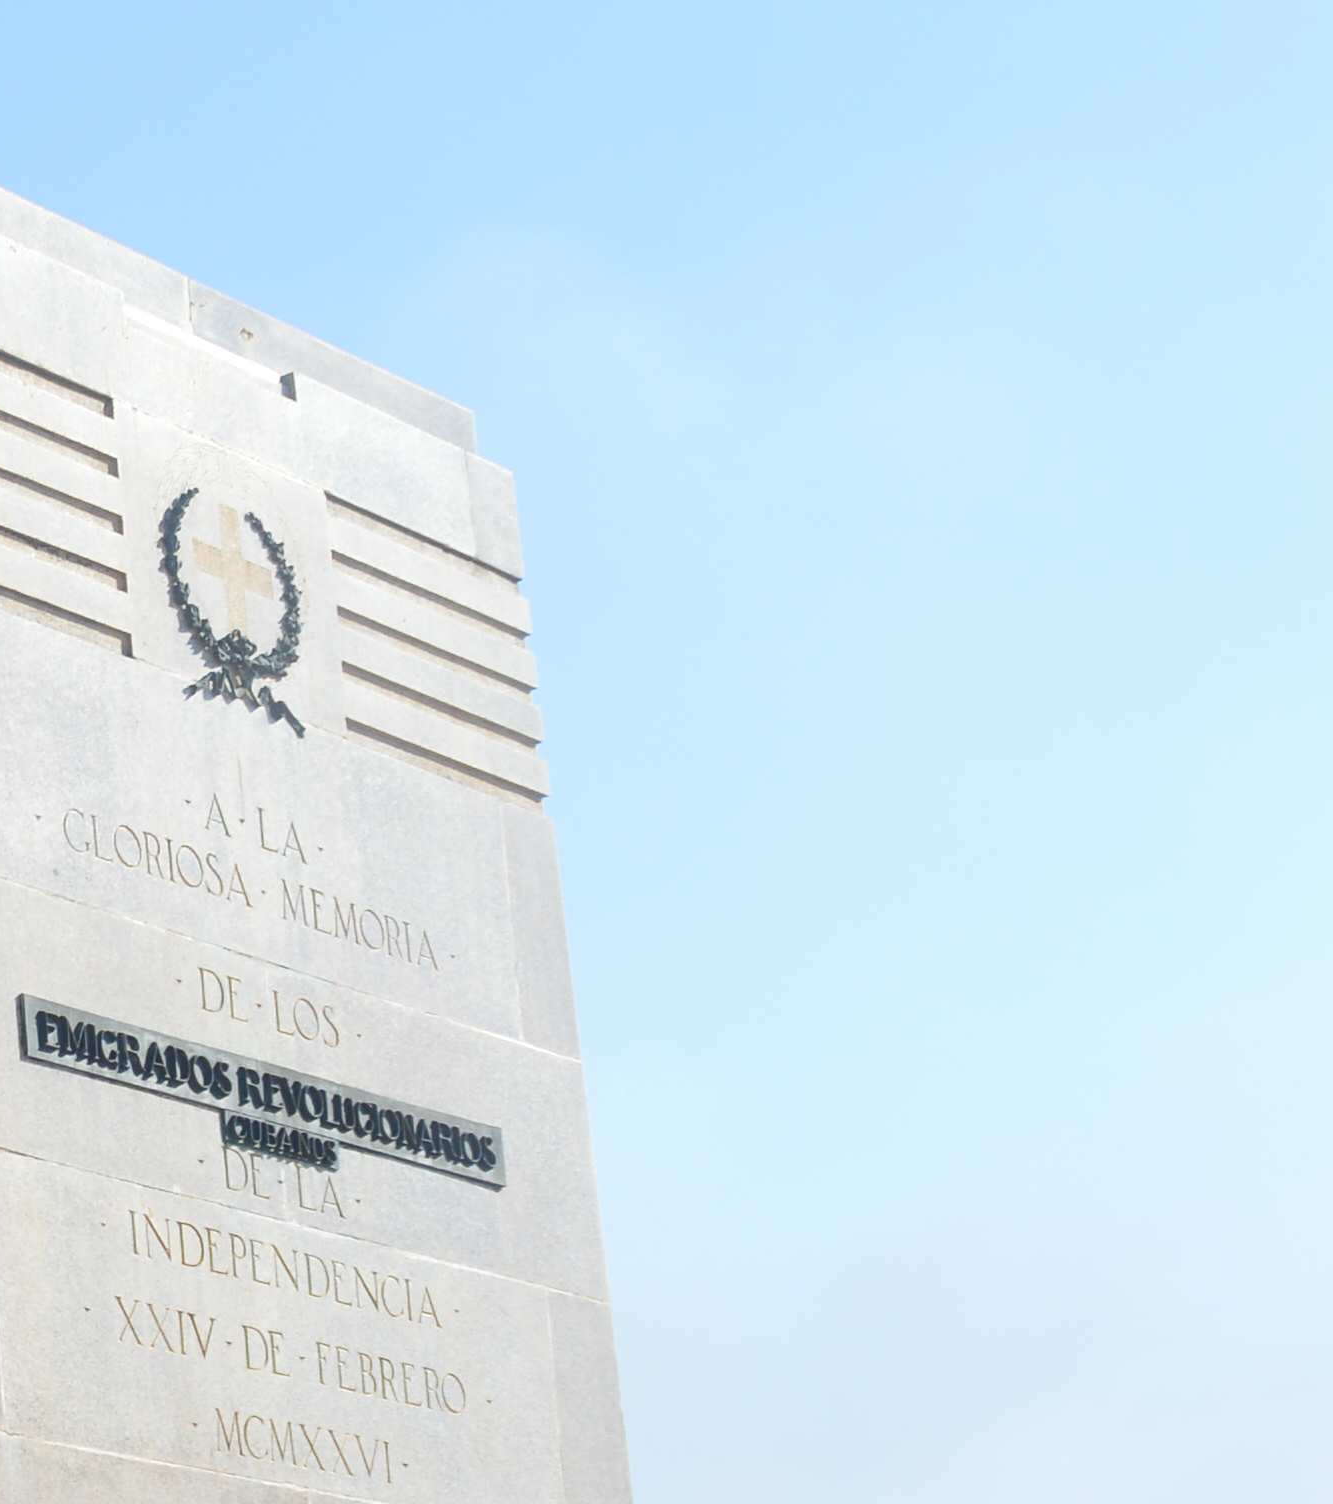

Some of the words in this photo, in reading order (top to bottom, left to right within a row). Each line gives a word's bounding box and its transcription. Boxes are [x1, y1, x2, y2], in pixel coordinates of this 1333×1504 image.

[204, 793, 231, 838] A
[257, 807, 308, 865] LA
[63, 808, 253, 908] GLORIOSA
[281, 878, 439, 971] MEMORIA
[198, 966, 248, 1023] DE
[272, 989, 339, 1048] LOS
[34, 1009, 233, 1100] EMIGRADOS
[236, 1066, 498, 1173] REVOLUCIONARIOS
[226, 1115, 337, 1166] CUBANOS
[220, 1145, 270, 1200] DE
[294, 1162, 346, 1219] LA
[128, 1209, 442, 1329] INDEPENDENCIA
[114, 1295, 216, 1359] XXIV
[241, 1324, 290, 1377] DE
[315, 1341, 466, 1415] FEBRERO
[215, 1407, 392, 1483] MCMXXVI
